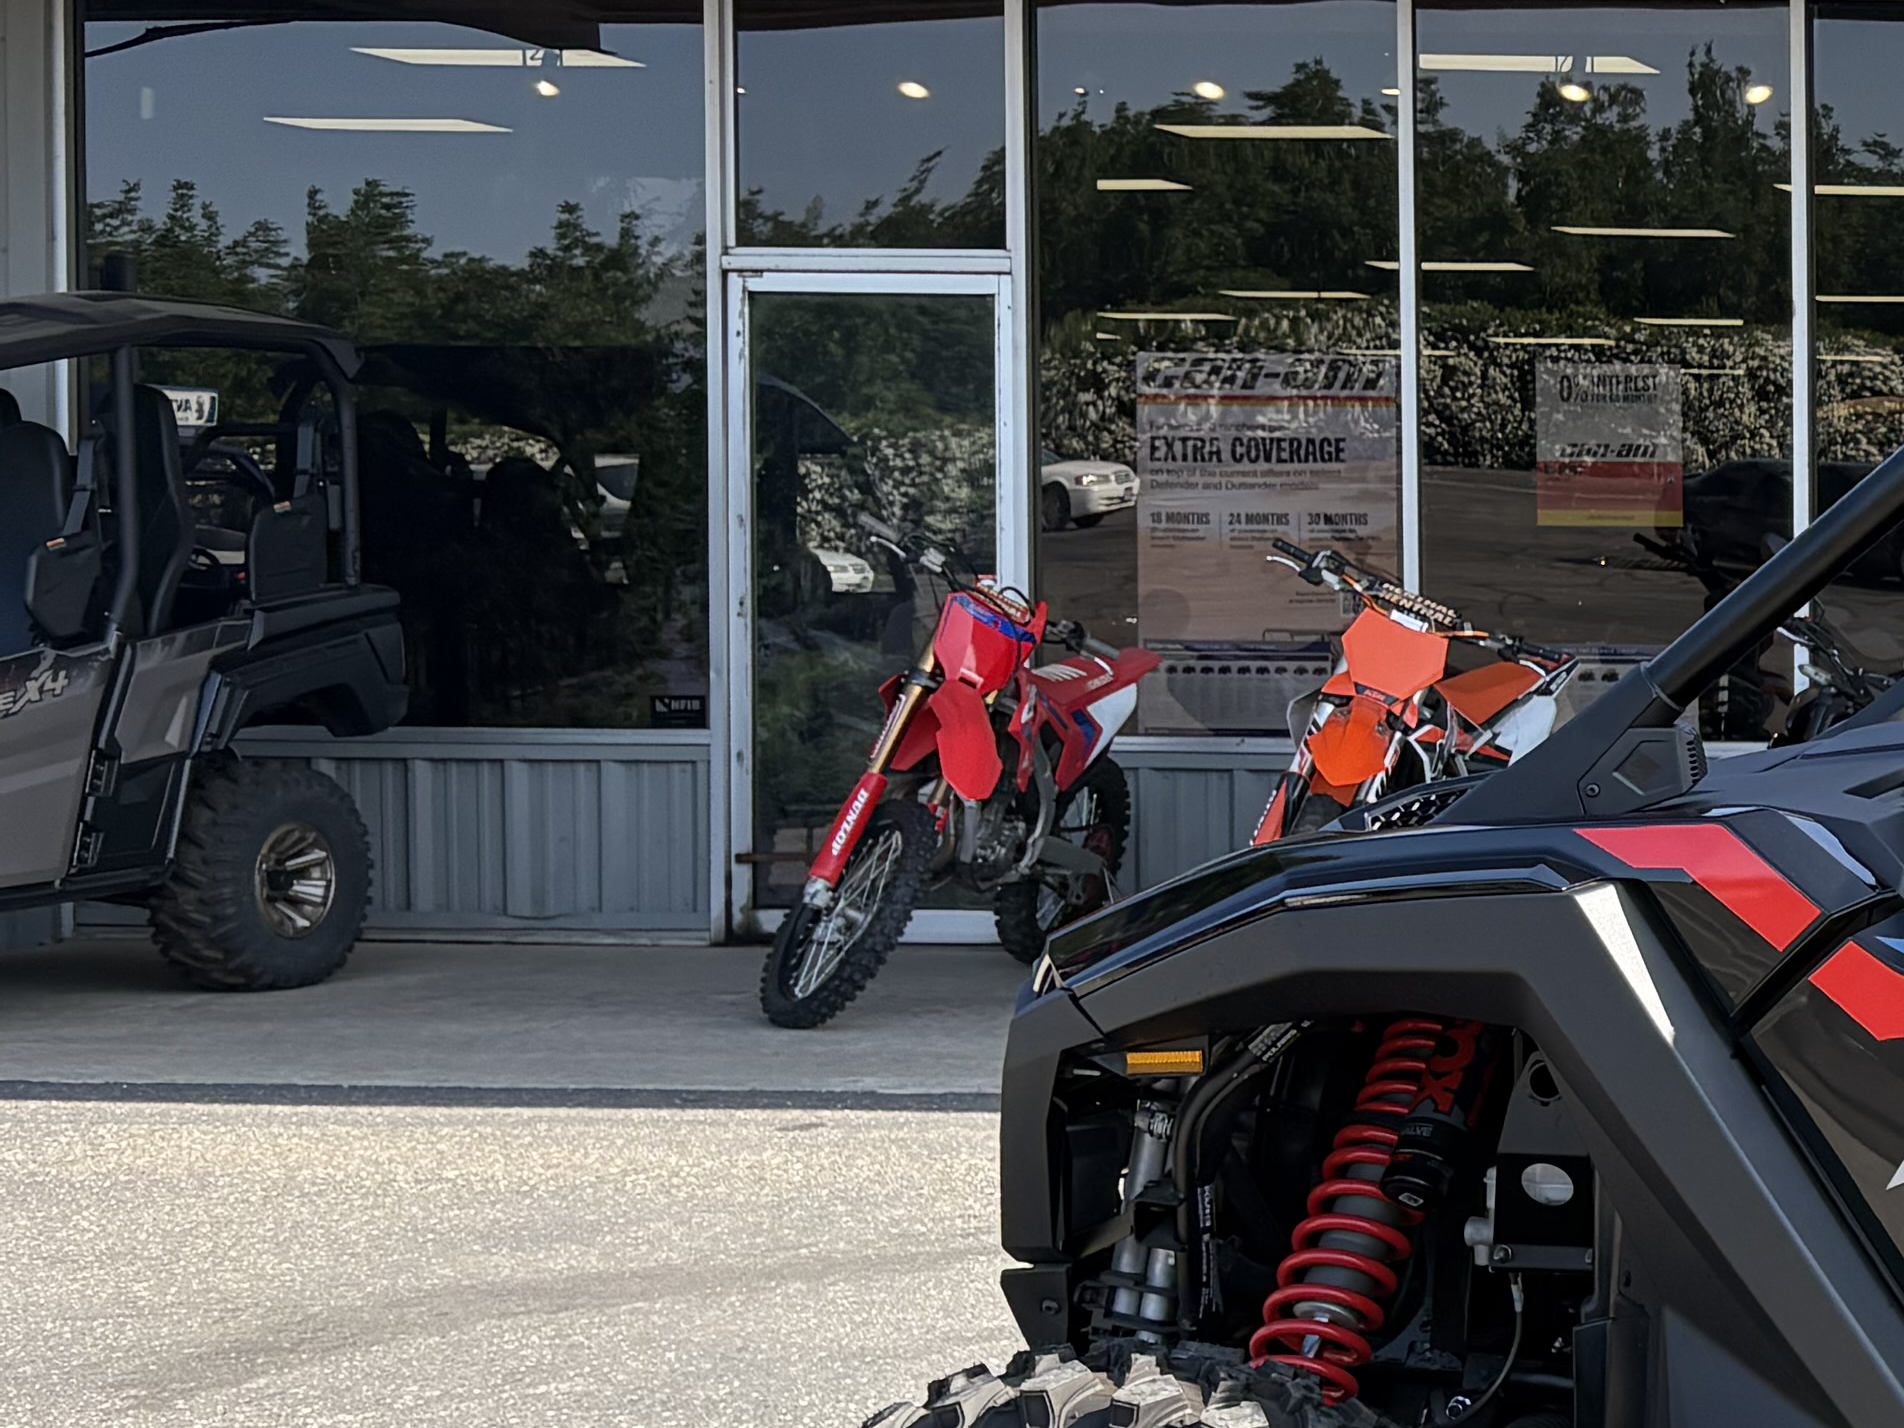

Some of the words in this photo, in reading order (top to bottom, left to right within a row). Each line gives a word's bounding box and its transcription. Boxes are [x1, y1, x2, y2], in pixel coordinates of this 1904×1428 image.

[1149, 437, 1223, 463] EXTRA
[1230, 437, 1347, 463] COVERAGE
[831, 787, 870, 857] DUNLOP
